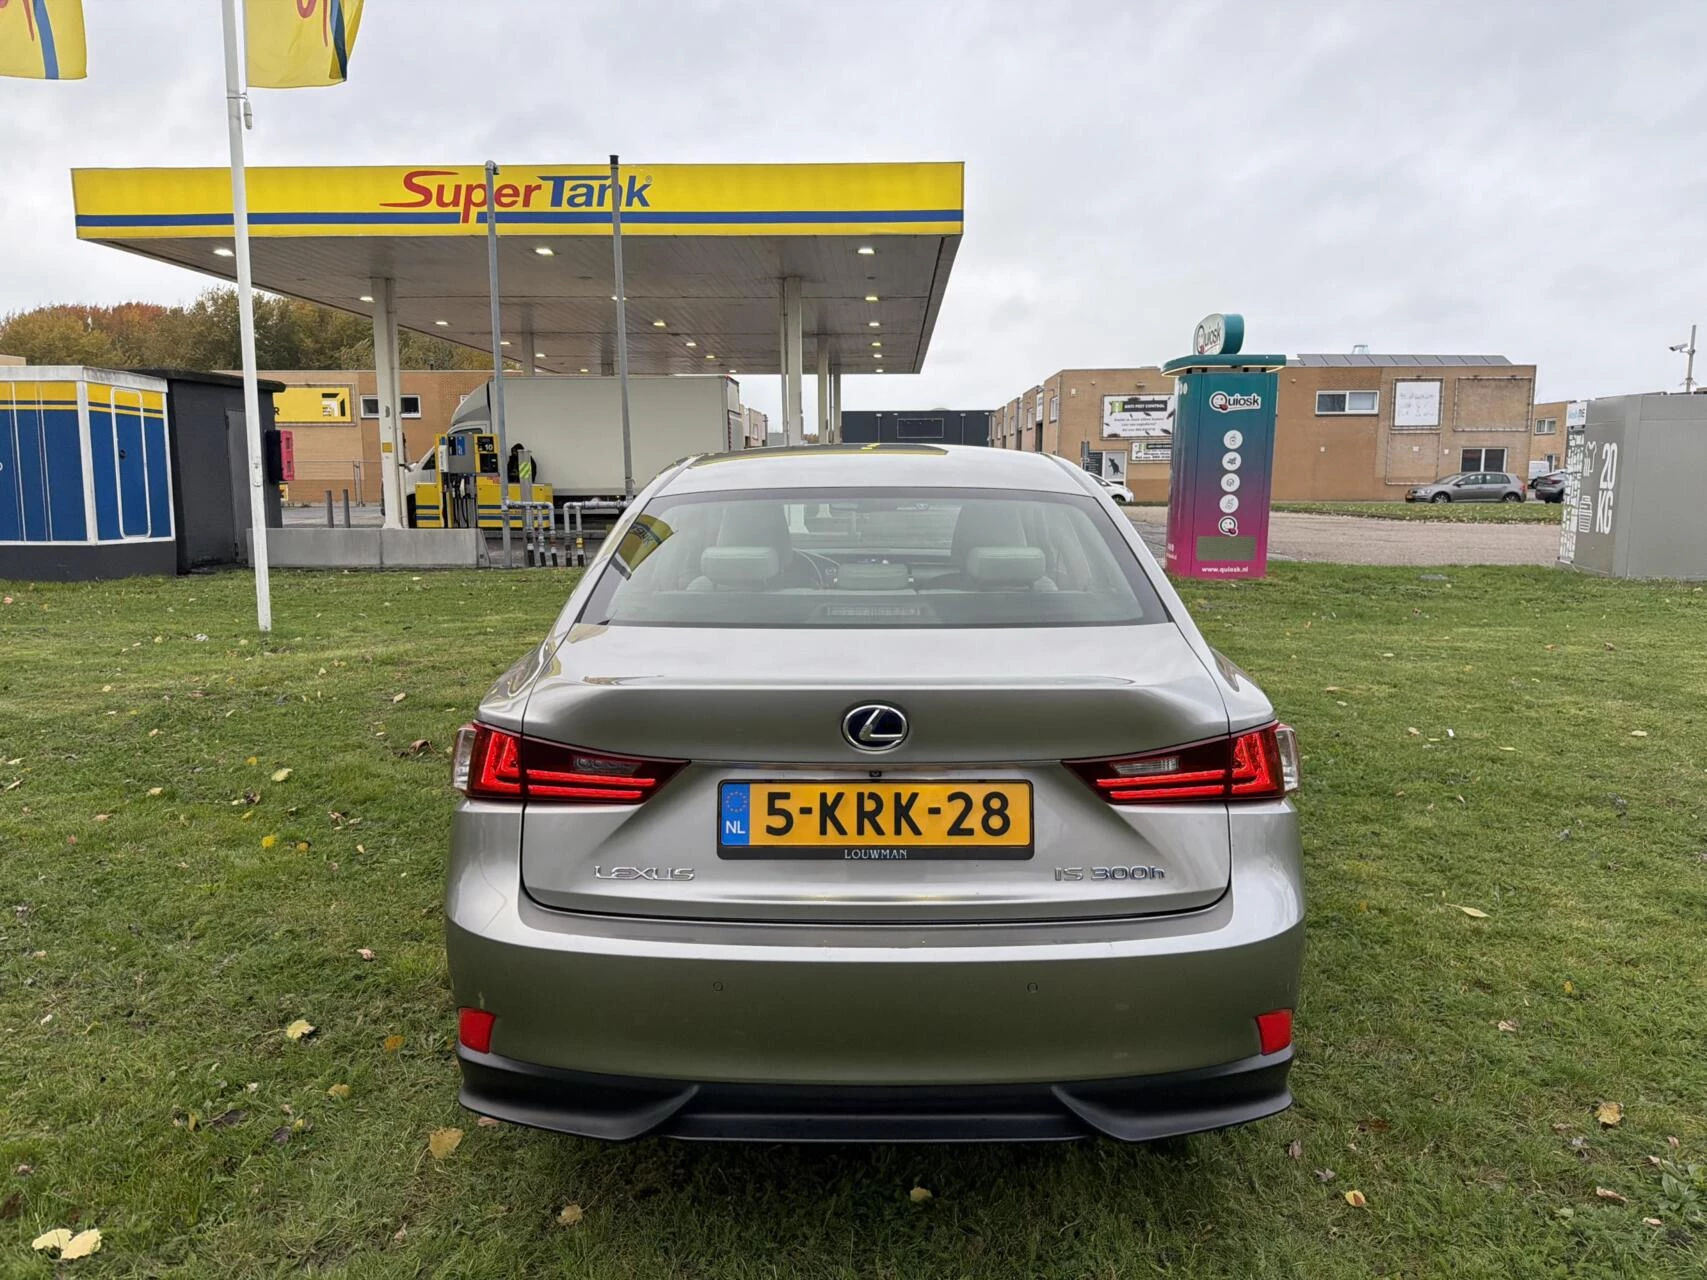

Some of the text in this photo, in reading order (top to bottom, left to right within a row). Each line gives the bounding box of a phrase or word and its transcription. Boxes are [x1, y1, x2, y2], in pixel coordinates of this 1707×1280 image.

[1197, 324, 1222, 354] Quiosk
[1210, 392, 1260, 411] Quiosk
[1599, 442, 1618, 490] 20
[1595, 490, 1614, 535] KG
[1202, 566, 1248, 574] www.quiosk.nl
[765, 791, 1011, 837] 5-KRK-28
[725, 820, 746, 834] NL
[844, 849, 908, 860] LOUWMAN
[594, 865, 695, 881] LEXUS
[1054, 865, 1166, 881] IS 300h
